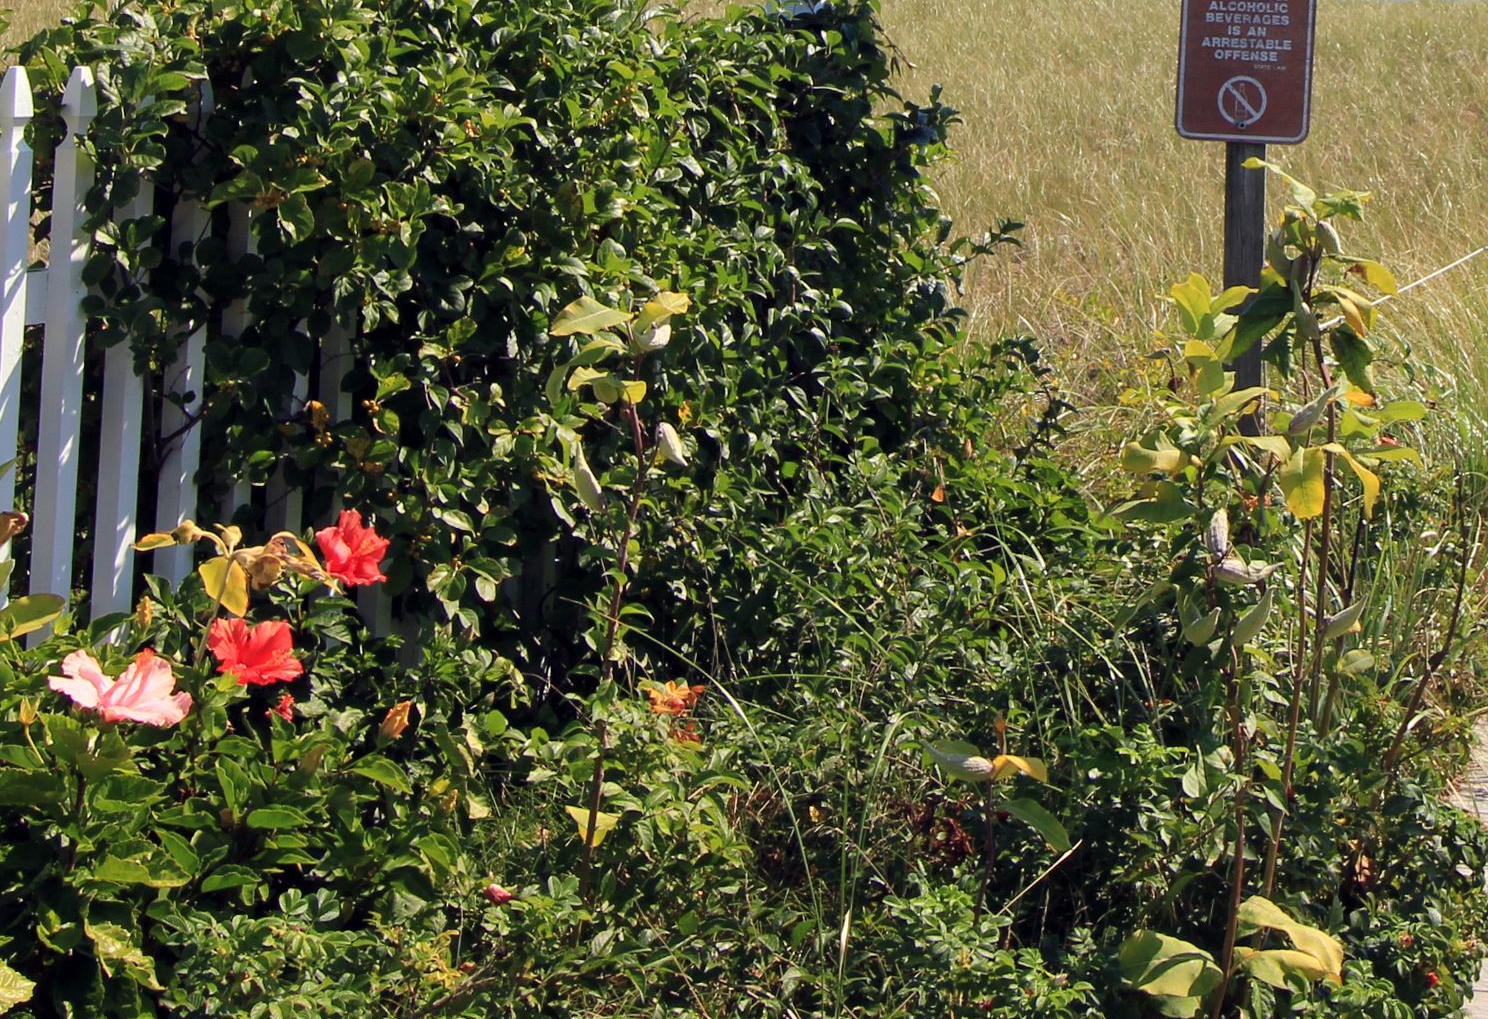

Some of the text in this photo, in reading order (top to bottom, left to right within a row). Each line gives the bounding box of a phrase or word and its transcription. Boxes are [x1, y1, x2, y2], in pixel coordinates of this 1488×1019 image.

[1209, 1, 1288, 13] ALCOHOLIC
[1205, 13, 1289, 26] BEVERAGES
[1228, 25, 1266, 37] IS AN
[1202, 37, 1292, 51] ARRESTABLE
[1214, 51, 1278, 62] OFFENSE
